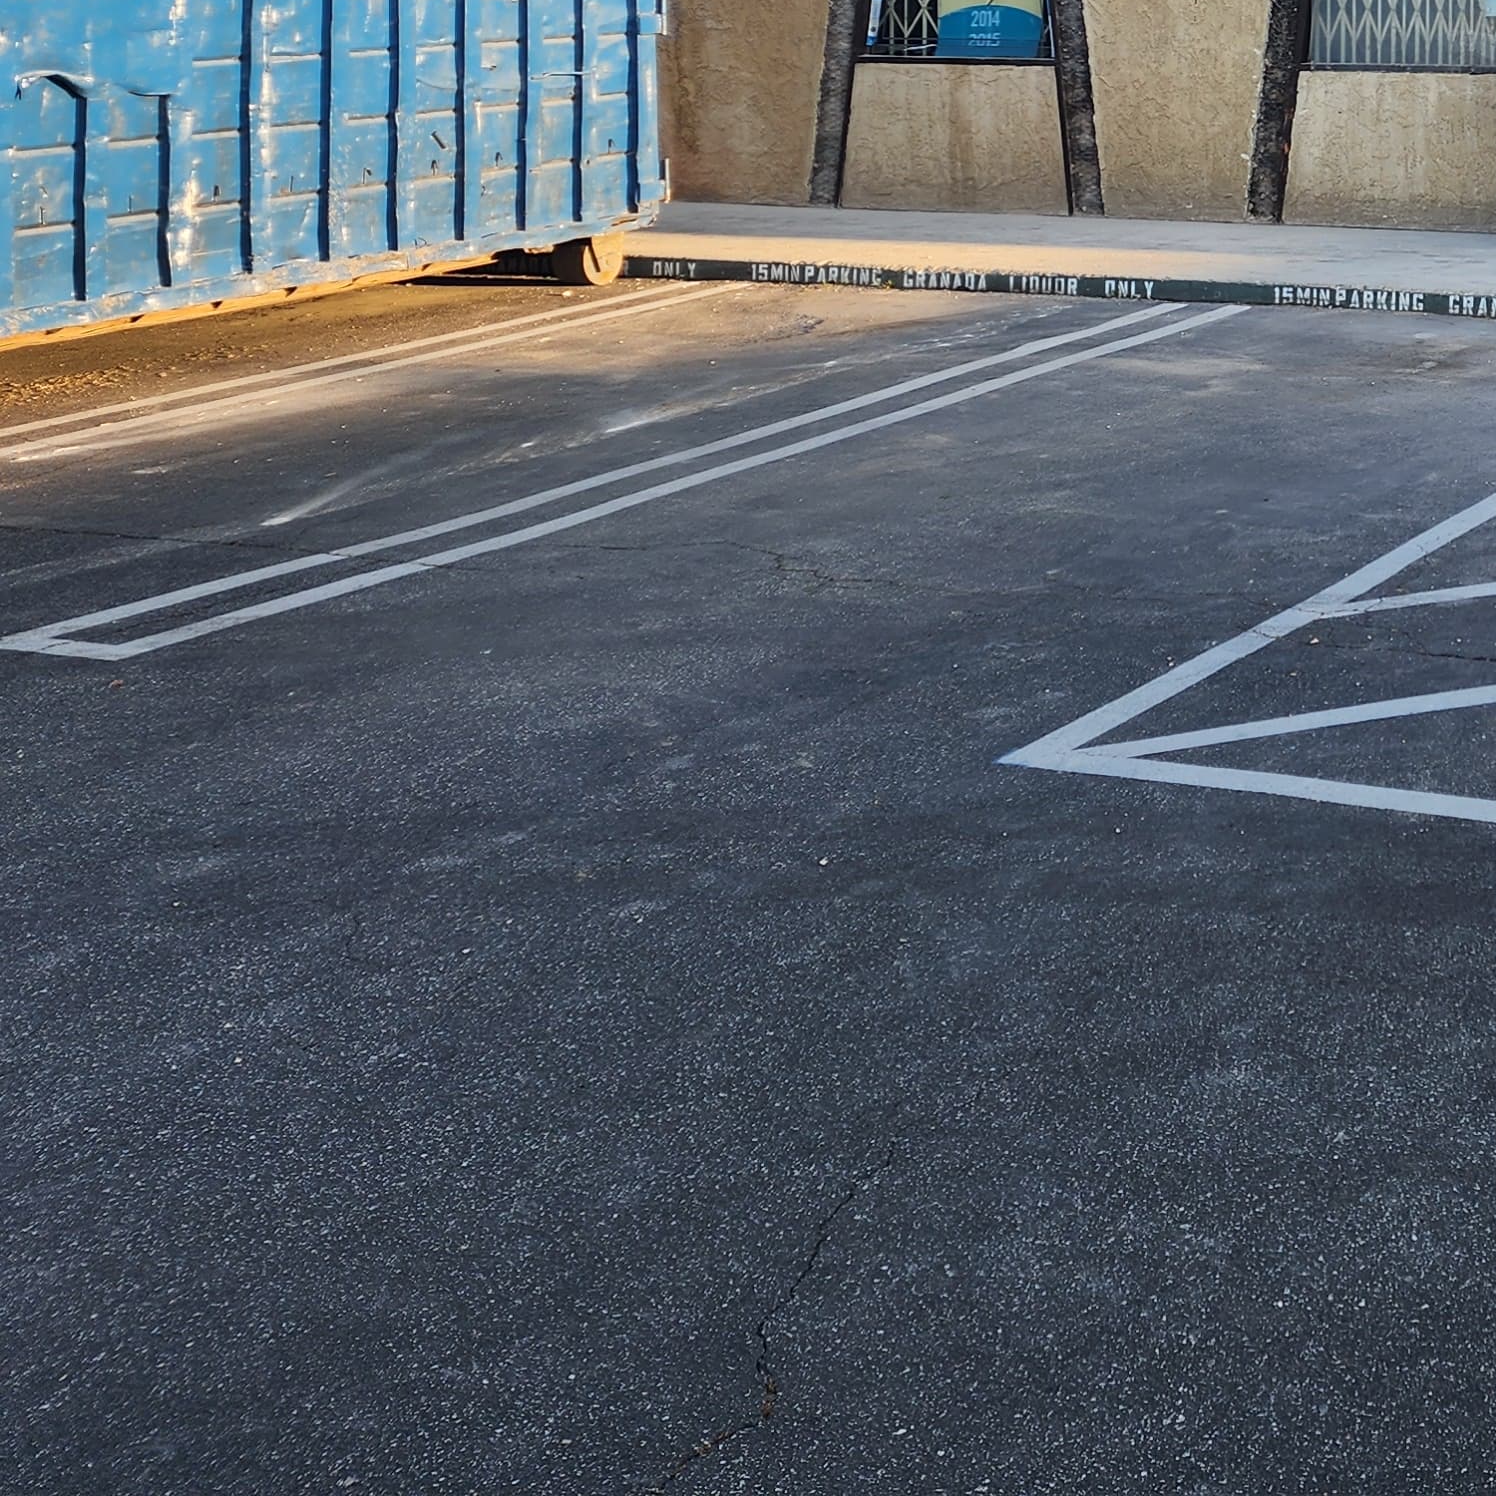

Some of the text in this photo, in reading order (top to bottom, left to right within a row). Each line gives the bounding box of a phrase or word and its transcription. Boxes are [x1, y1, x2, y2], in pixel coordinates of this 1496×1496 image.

[970, 10, 1000, 27] 2014
[652, 260, 697, 278] ONLY
[804, 264, 882, 286] PARKING
[903, 270, 987, 291] GRANADA
[1009, 276, 1078, 296] LIQUOR
[1104, 279, 1154, 299] ONLY
[1335, 287, 1424, 311] PARKING
